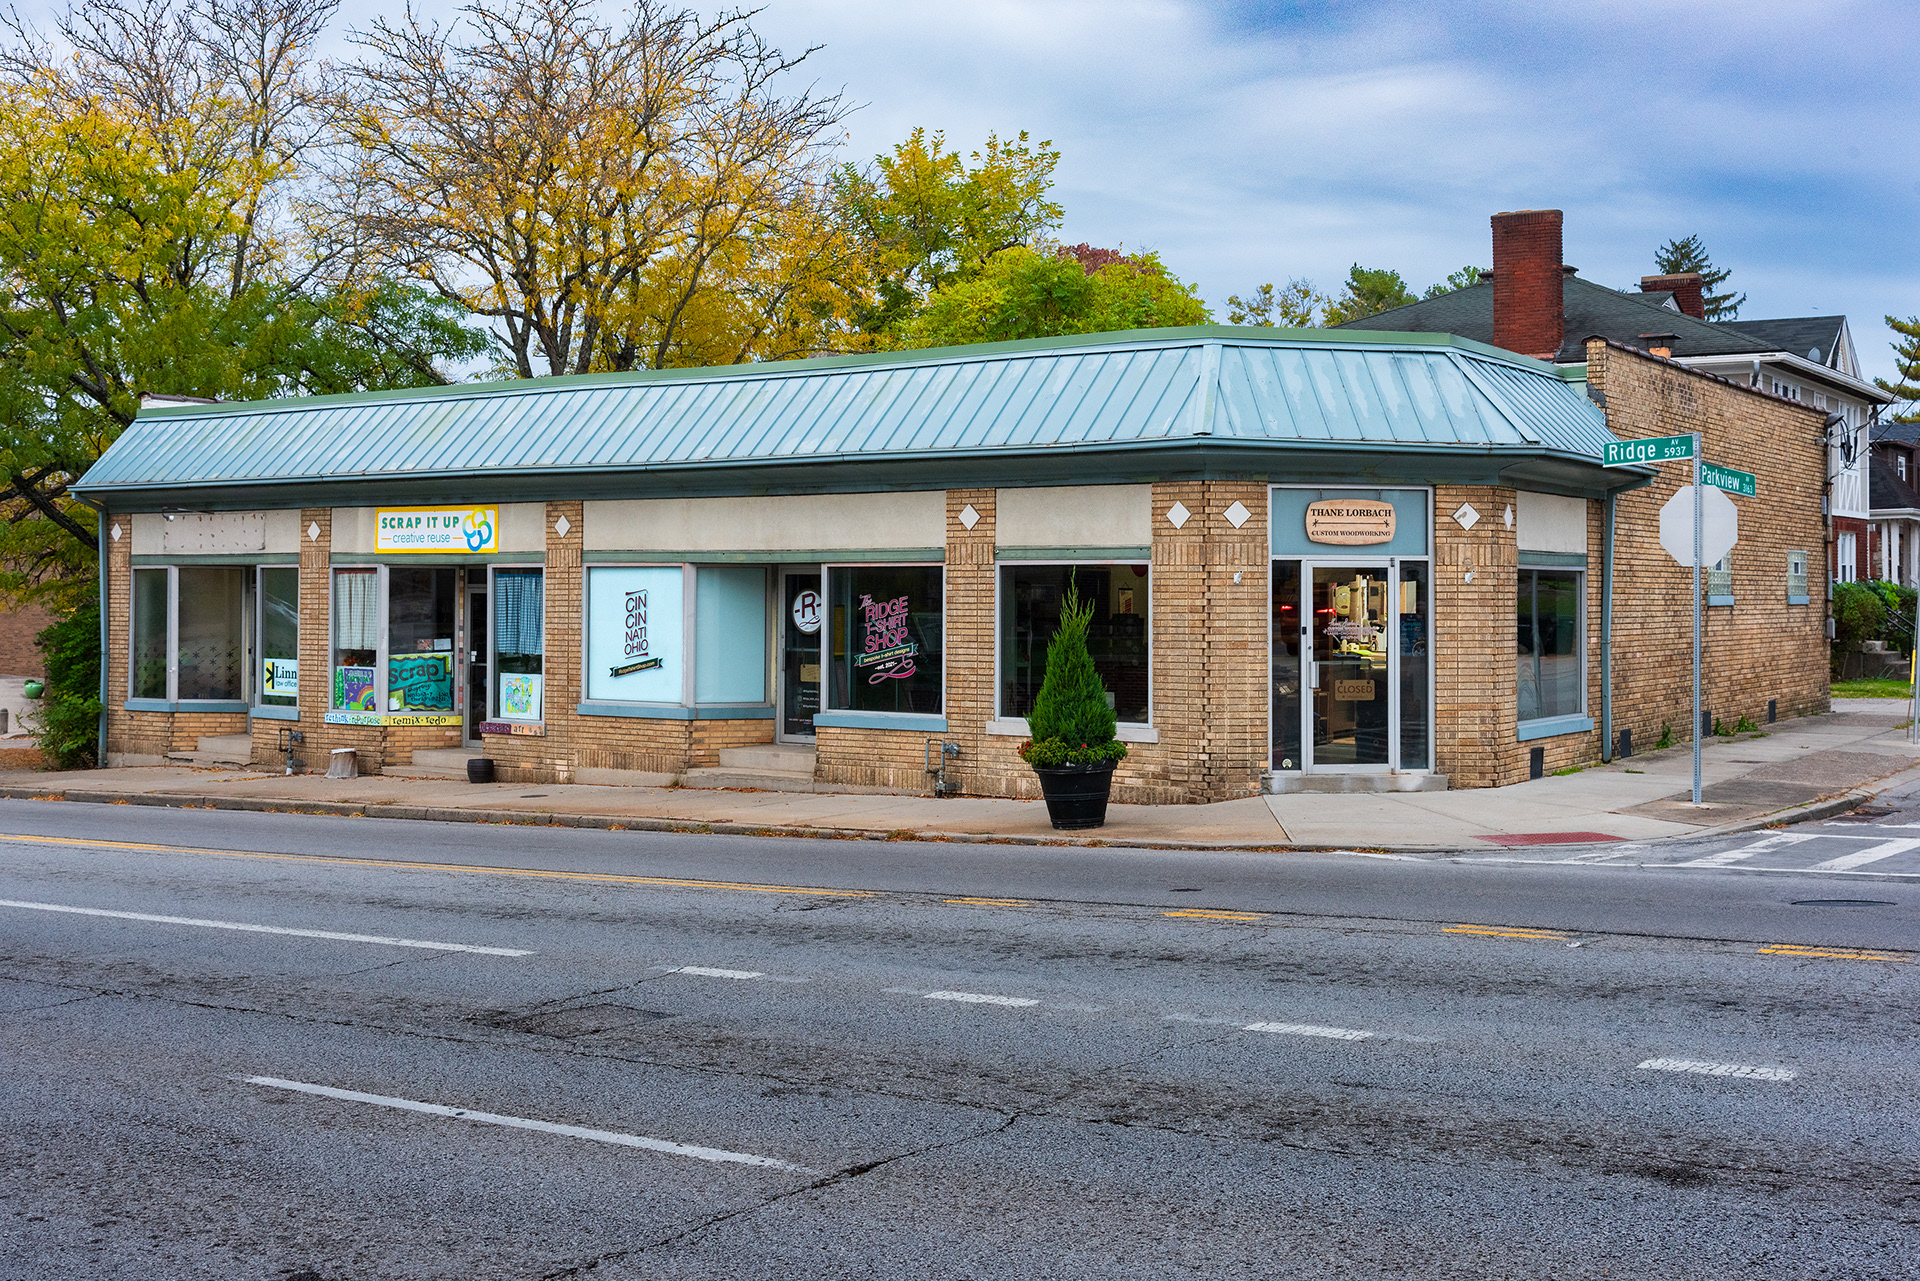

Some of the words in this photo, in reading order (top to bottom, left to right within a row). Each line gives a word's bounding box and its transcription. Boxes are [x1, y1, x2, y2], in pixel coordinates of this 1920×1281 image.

[1608, 443, 1656, 462] Ridge
[1664, 446, 1687, 457] 5937
[1701, 465, 1740, 490] Parkview
[1311, 508, 1344, 517] THANE
[1345, 508, 1392, 517] LORBACH
[381, 516, 422, 529] SCRAP
[426, 516, 438, 529] IT
[443, 515, 460, 528] UP
[392, 531, 425, 543] creative
[427, 533, 451, 543] reuse
[625, 593, 647, 613] CIN
[858, 594, 876, 610] The
[865, 595, 909, 622] RIDGE
[625, 610, 647, 629] CIN
[864, 612, 909, 635] T-SHIRT
[625, 626, 647, 643] NATI
[864, 627, 909, 653] SHOP
[624, 638, 649, 655] OHIO
[275, 666, 297, 679] Linn
[1337, 685, 1373, 694] CLOSED
[392, 715, 420, 725] remix
[425, 715, 447, 725] redo
